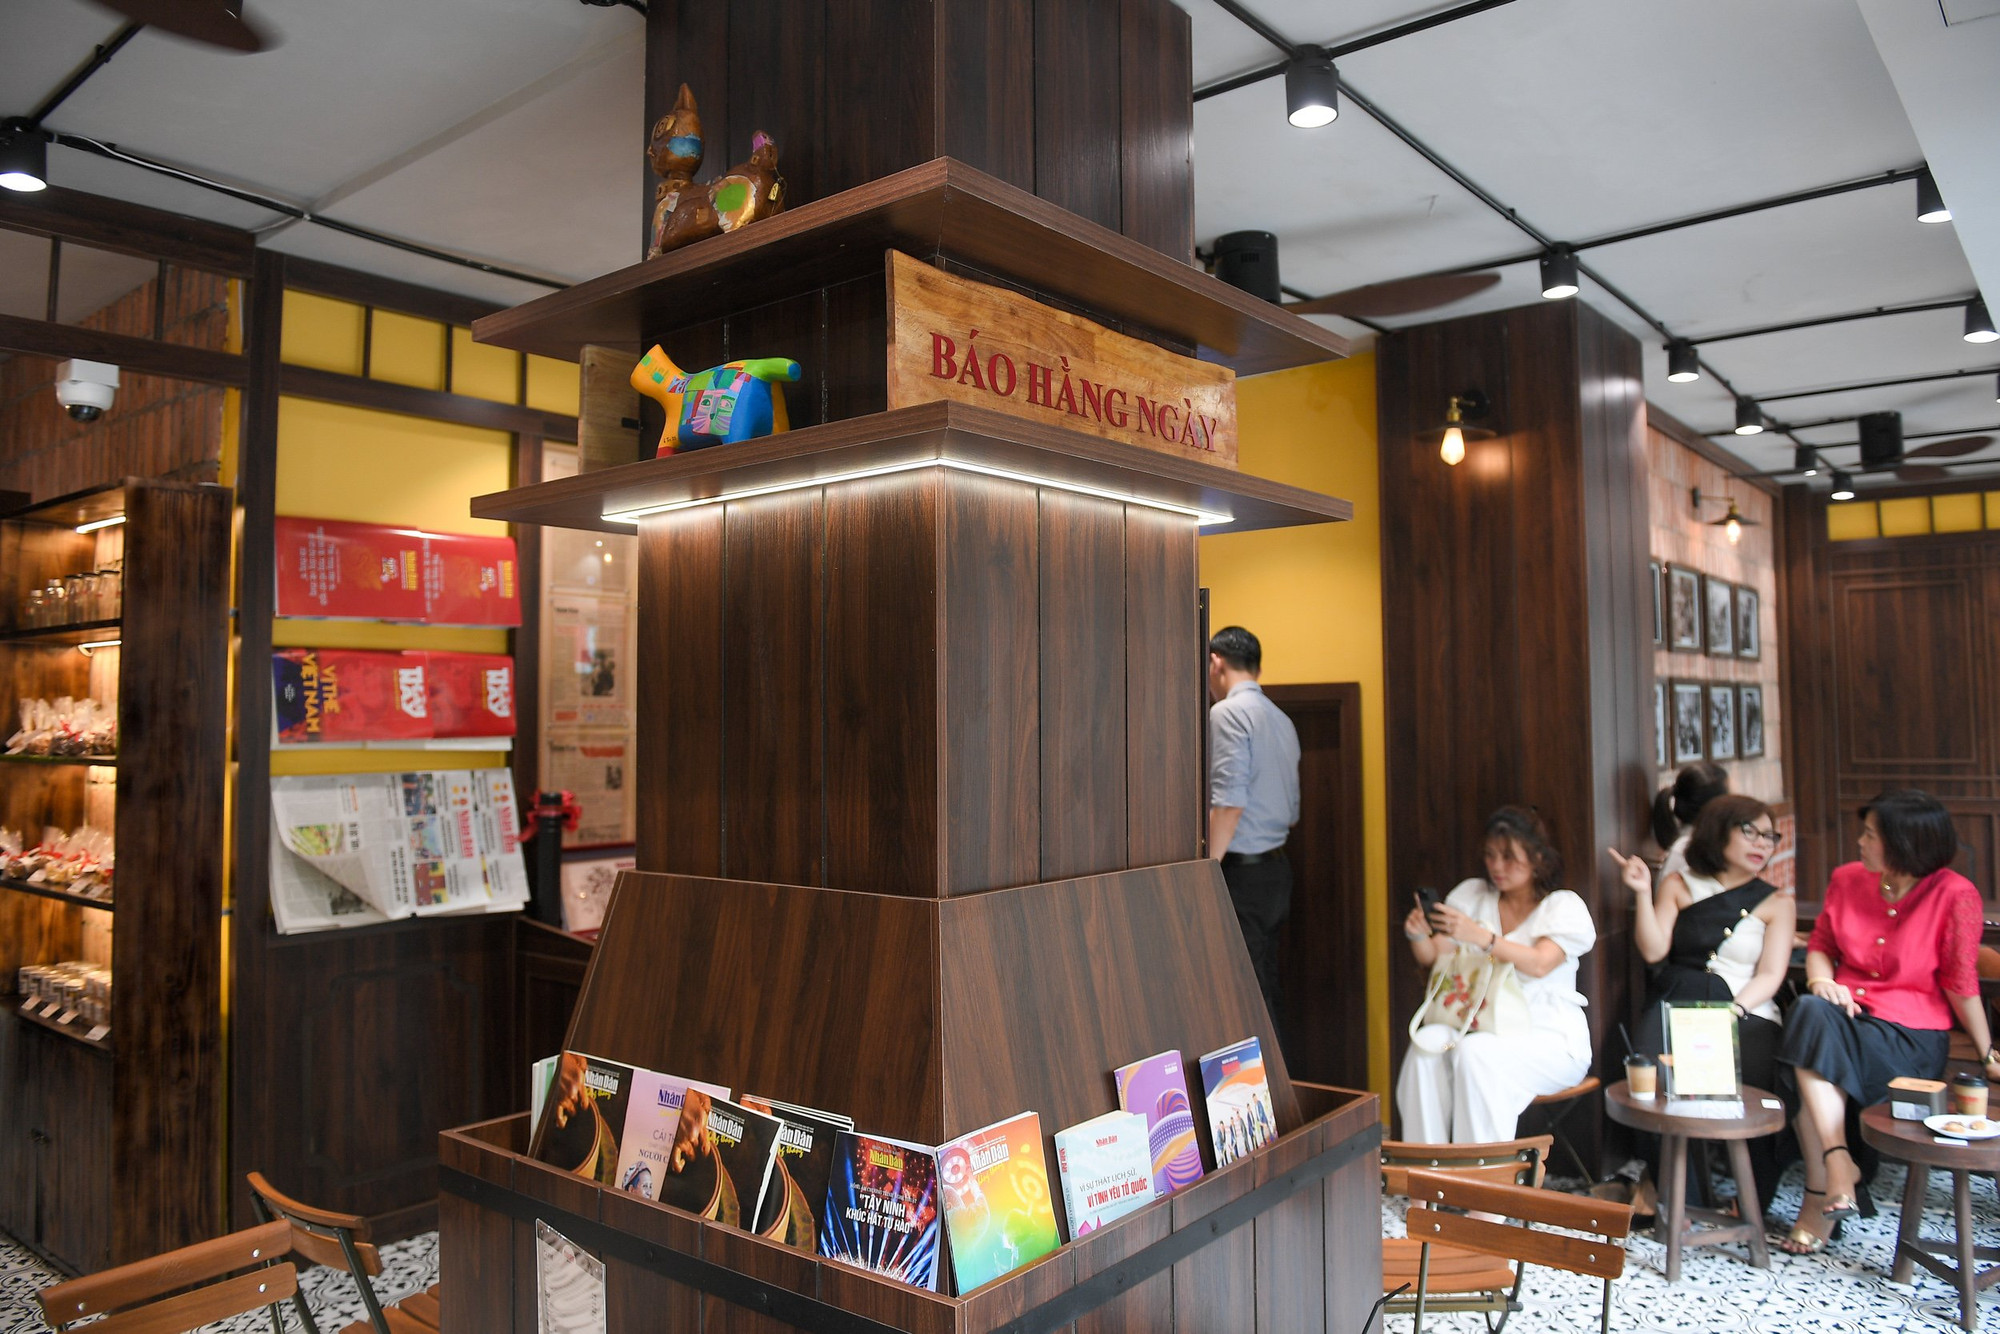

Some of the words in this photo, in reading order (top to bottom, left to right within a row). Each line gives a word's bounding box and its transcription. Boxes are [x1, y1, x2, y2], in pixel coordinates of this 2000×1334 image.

[929, 328, 1017, 397] BÁO
[1026, 355, 1129, 428] HẰNG
[1135, 395, 1219, 452] NGÀY
[303, 690, 320, 732] NAM
[584, 1069, 604, 1087] Nhân
[603, 1074, 619, 1091] Dân
[658, 1089, 681, 1106] Nhân
[708, 1111, 728, 1133] Nhân
[727, 1119, 744, 1139] Dân
[793, 1129, 813, 1149] Dân
[869, 1148, 889, 1165] Nhân
[889, 1154, 904, 1169] Dân
[969, 1149, 992, 1171] Nhân
[991, 1143, 1009, 1163] Dân
[1109, 1184, 1121, 1201] YÊU
[1130, 1174, 1148, 1194] QUỐC
[845, 1206, 867, 1223] KHÚC
[867, 1210, 884, 1227] HÁT
[883, 1216, 894, 1231] TỰ
[882, 1198, 906, 1218] NINH
